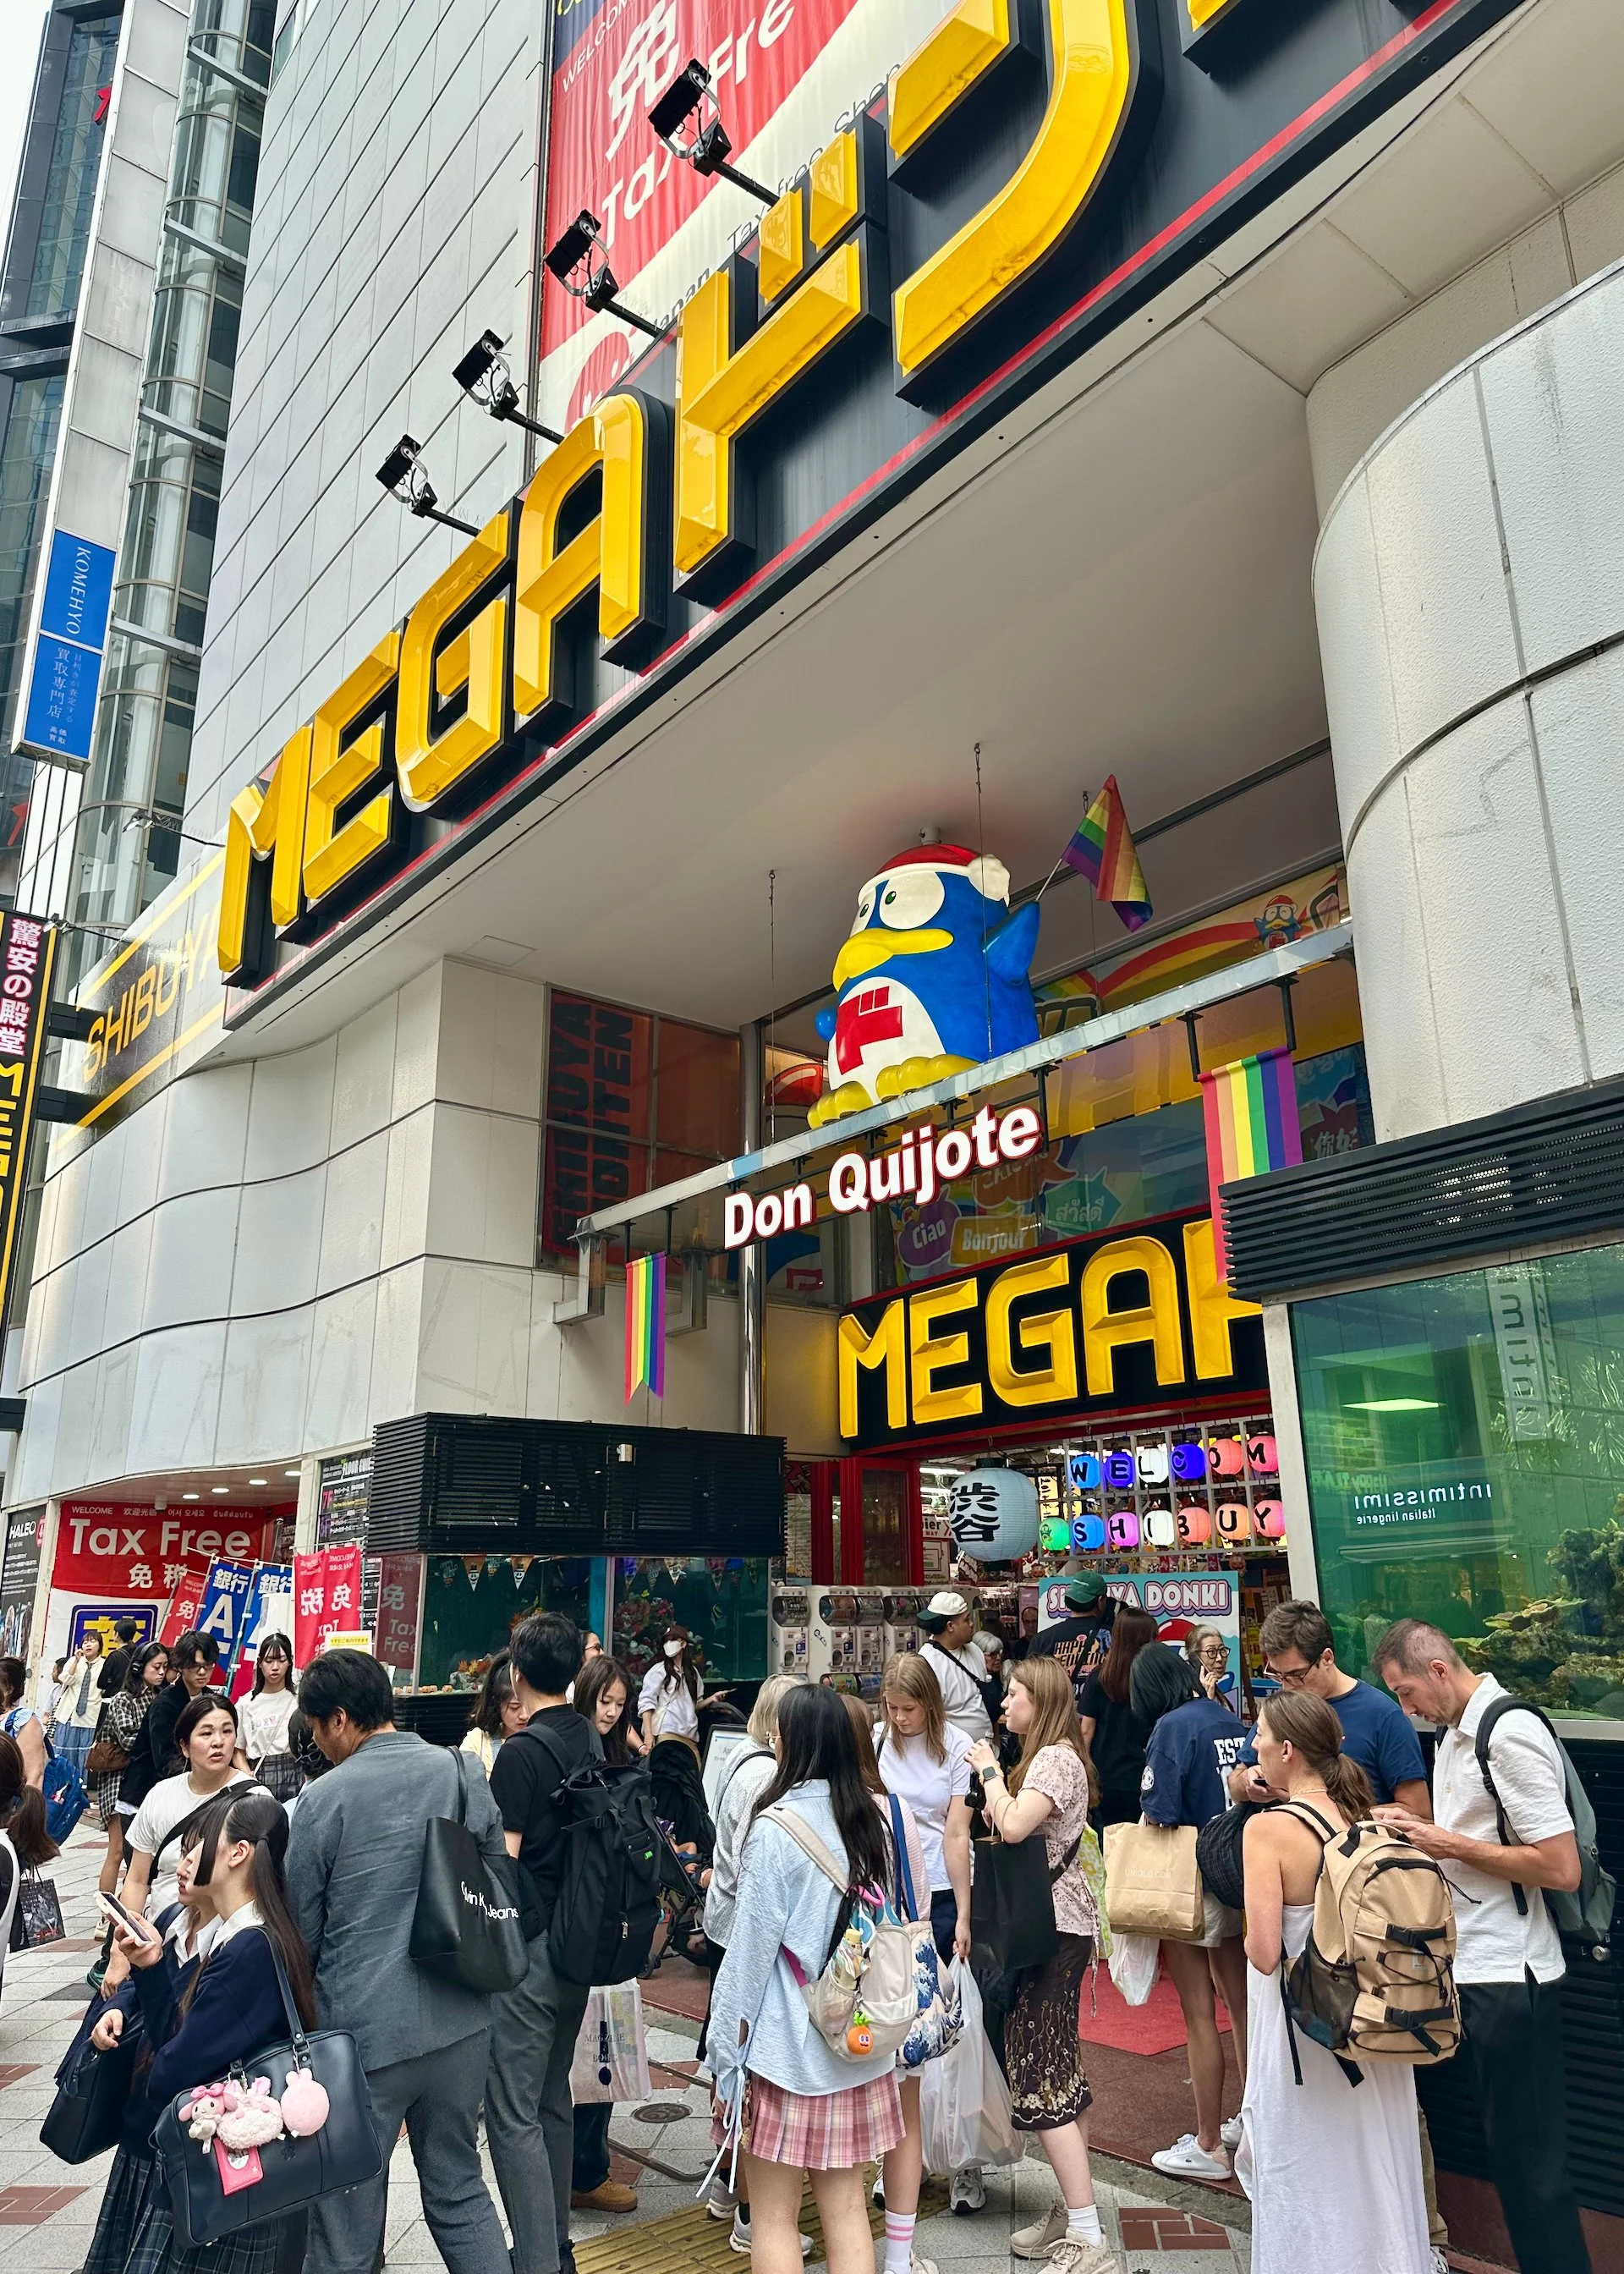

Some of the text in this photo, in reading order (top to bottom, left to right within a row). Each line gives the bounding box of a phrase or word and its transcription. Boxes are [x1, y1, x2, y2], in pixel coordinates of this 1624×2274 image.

[66, 546, 91, 635] KOMEHYO
[46, 645, 70, 721] 買取専門店
[0, 917, 42, 1057] 驚安の殿堂
[724, 1183, 815, 1250] Don
[828, 1103, 1044, 1214] Quijote
[912, 1217, 946, 1250] Ciao
[962, 1227, 1028, 1255] Bonjour
[71, 1506, 113, 1515] WELCOME
[949, 1482, 1001, 1543] 渋谷
[8, 1520, 36, 1540] HALEO
[69, 1518, 251, 1557] Tax Free
[212, 1568, 250, 1594] 銀行
[1146, 1581, 1228, 1609] DONKI
[488, 1903, 518, 1920] Jeans
